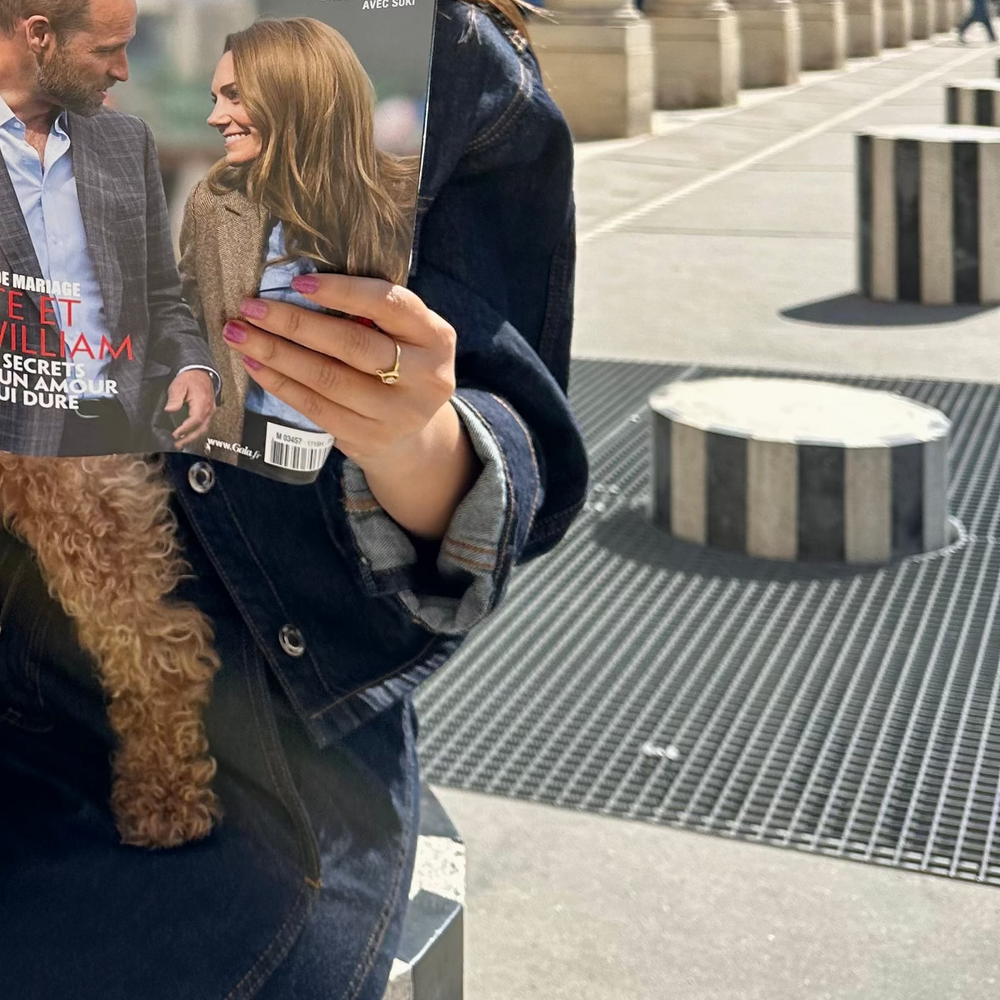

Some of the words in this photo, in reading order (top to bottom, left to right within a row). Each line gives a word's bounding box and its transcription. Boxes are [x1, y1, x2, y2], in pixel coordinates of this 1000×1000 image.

[12, 273, 81, 297] MARIAGE
[40, 295, 82, 327] ET
[2, 353, 86, 378] SECRETS
[34, 376, 119, 395] AMOUR
[23, 390, 80, 410] DURE
